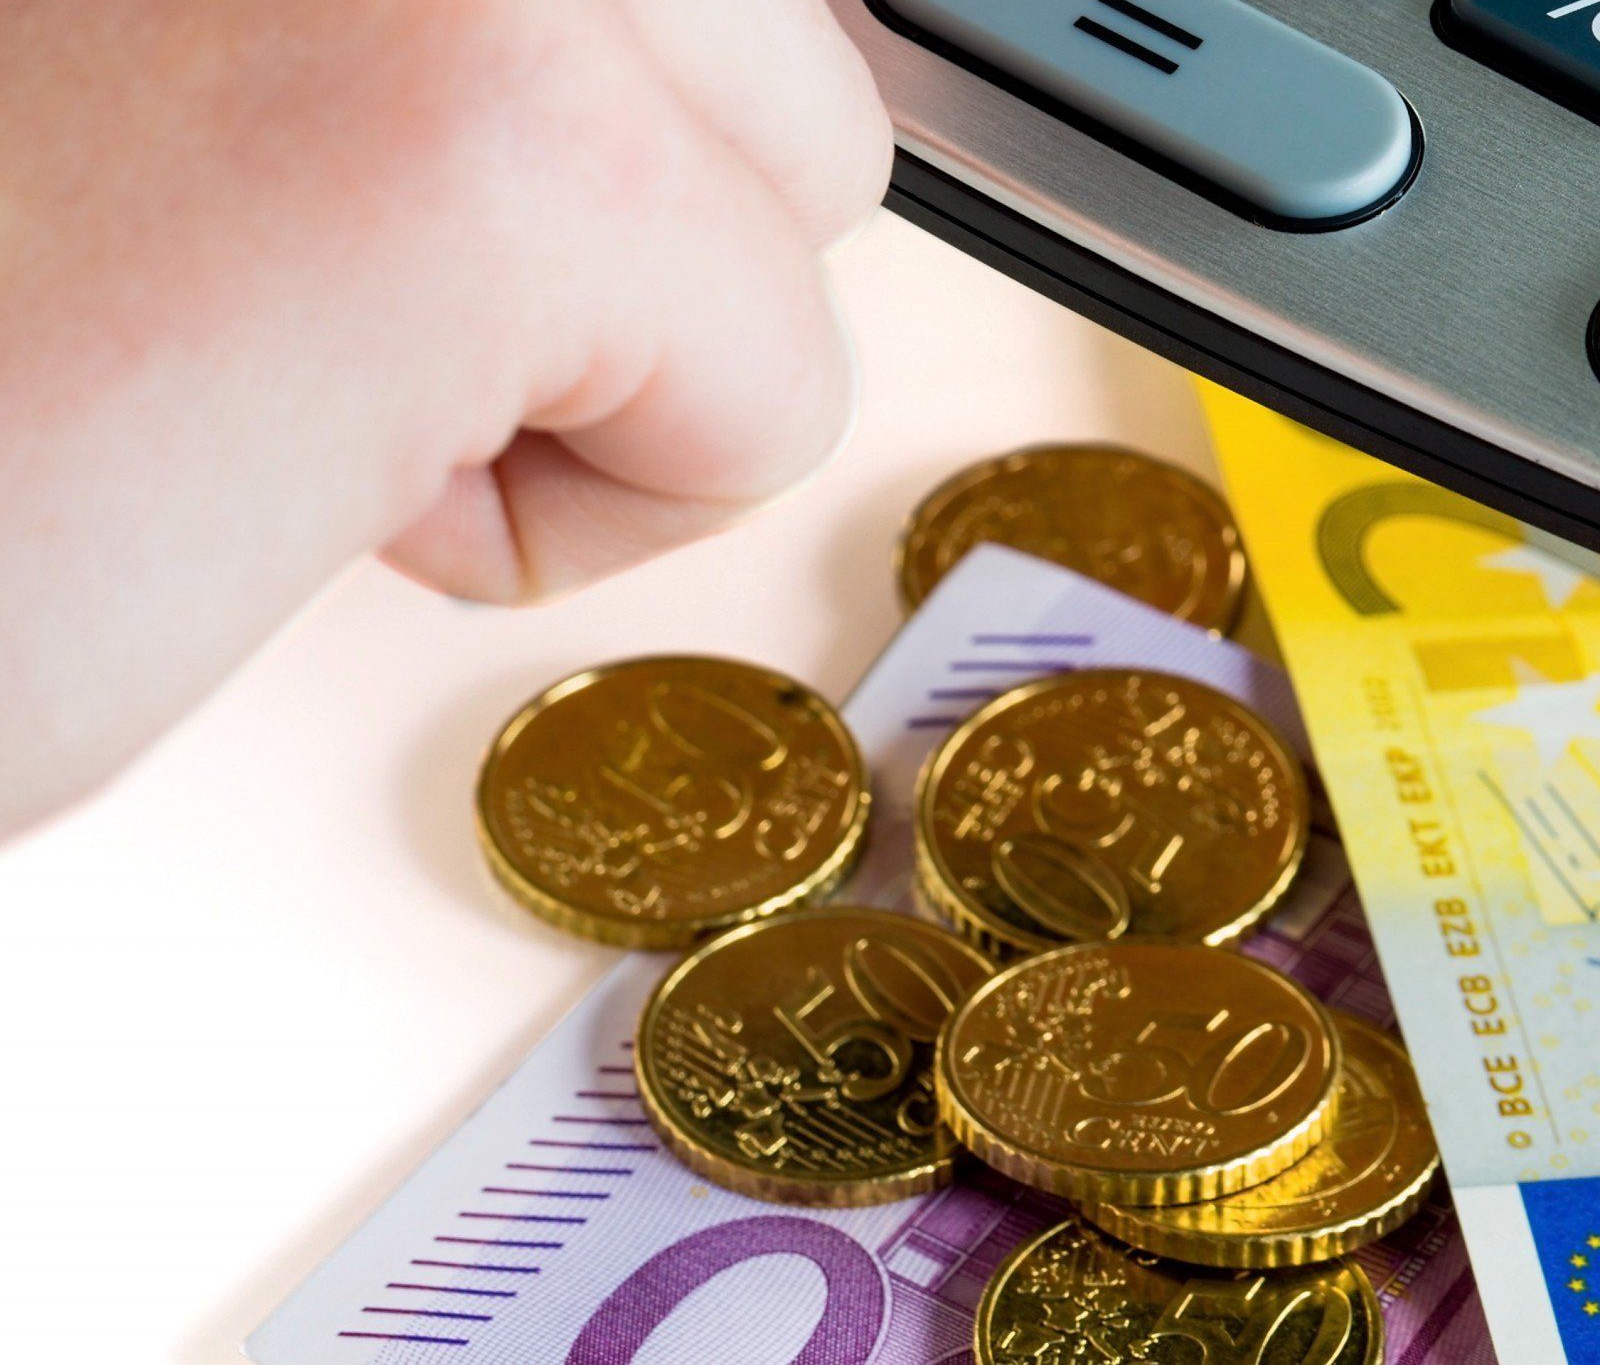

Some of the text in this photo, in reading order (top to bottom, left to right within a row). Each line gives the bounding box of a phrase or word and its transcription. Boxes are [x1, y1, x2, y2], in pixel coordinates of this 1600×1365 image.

[1408, 817, 1457, 878] EKT
[1434, 895, 1481, 958] EZB
[1458, 973, 1508, 1037] ECB
[1077, 1008, 1313, 1116] 50
[1483, 1054, 1533, 1117] BCE
